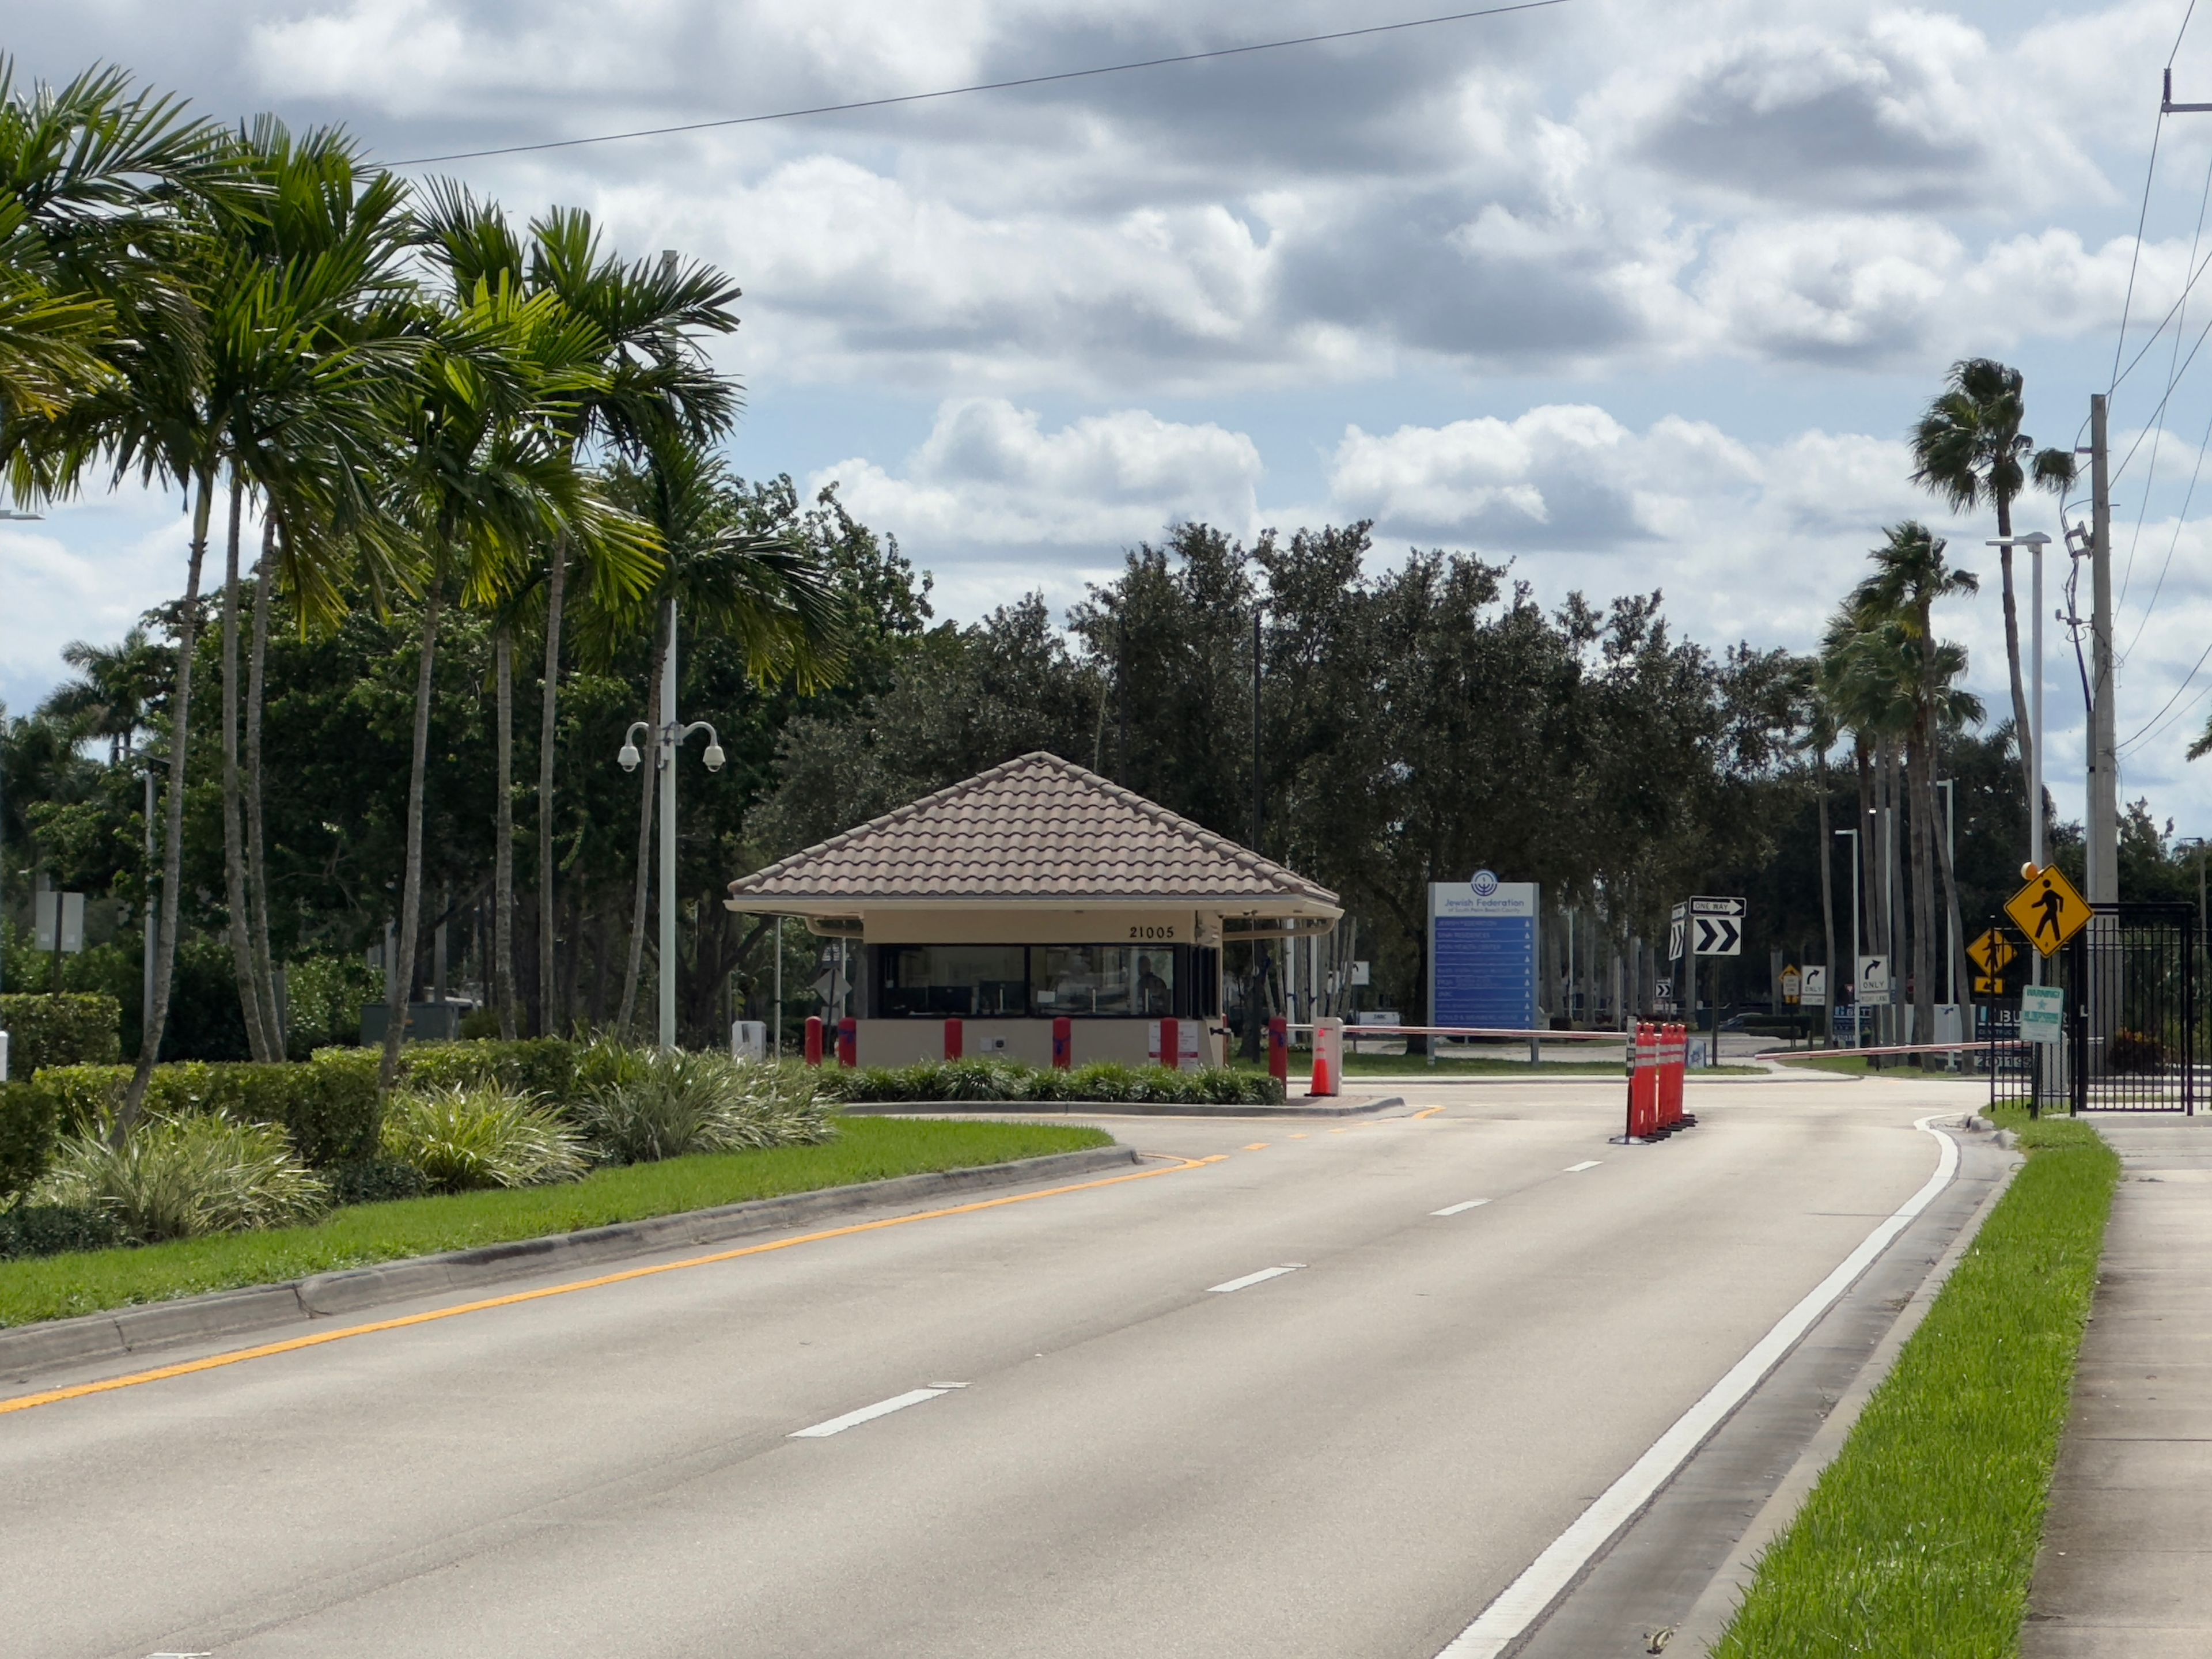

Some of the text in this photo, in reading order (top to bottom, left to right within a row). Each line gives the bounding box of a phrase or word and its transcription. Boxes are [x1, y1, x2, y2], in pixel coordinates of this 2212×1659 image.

[1444, 898, 1524, 907] Jewish Federation
[1129, 926, 1174, 938] 21005
[1863, 980, 1884, 988] ONLY
